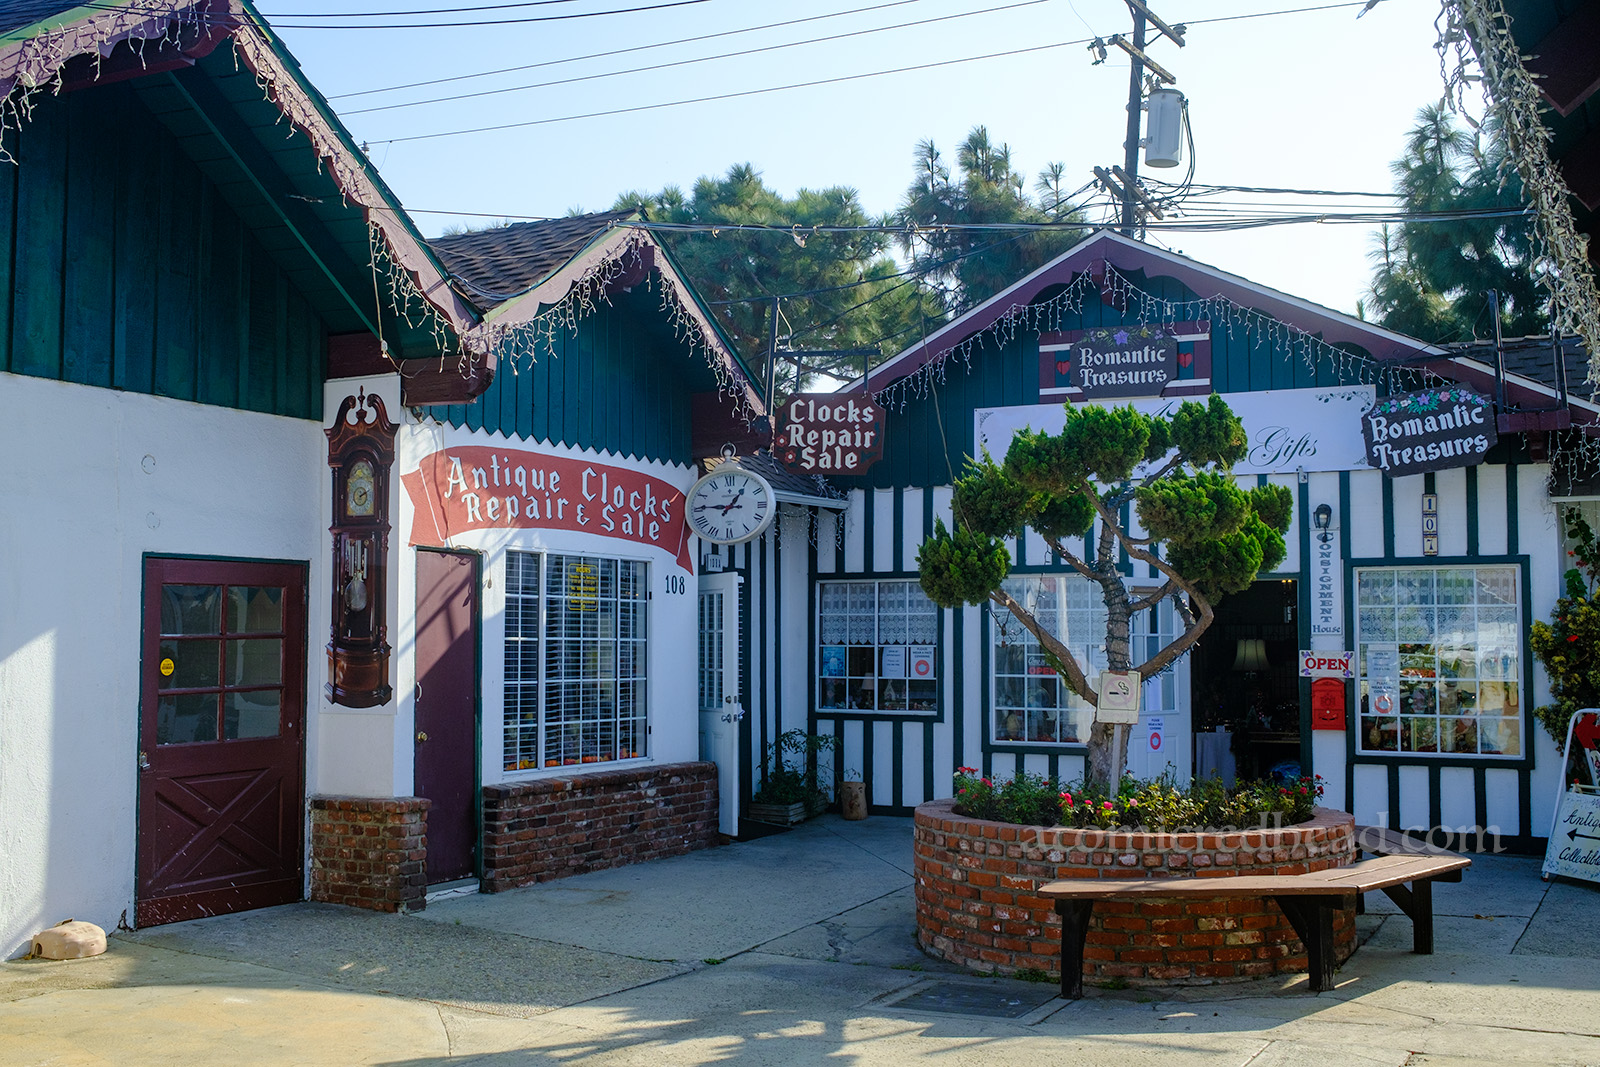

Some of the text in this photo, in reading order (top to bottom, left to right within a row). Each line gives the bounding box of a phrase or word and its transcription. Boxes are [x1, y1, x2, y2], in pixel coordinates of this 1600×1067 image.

[1079, 345, 1167, 369] Romantic
[1079, 366, 1168, 389] Treasures
[789, 399, 875, 424] Clocks
[1369, 403, 1485, 443] Romantic
[785, 424, 876, 453] Repair
[1248, 425, 1318, 468] Gifts
[800, 446, 858, 470] Sale
[1372, 432, 1489, 471] Treasures
[444, 453, 673, 524] Antique Clocks
[461, 490, 661, 541] Repair & Sale
[1425, 498, 1434, 551] 107
[664, 574, 686, 596] 108
[1312, 624, 1341, 633] House
[1028, 666, 1057, 675] OPEN
[1304, 657, 1350, 671] OPEN
[1562, 808, 1600, 833] Antiq
